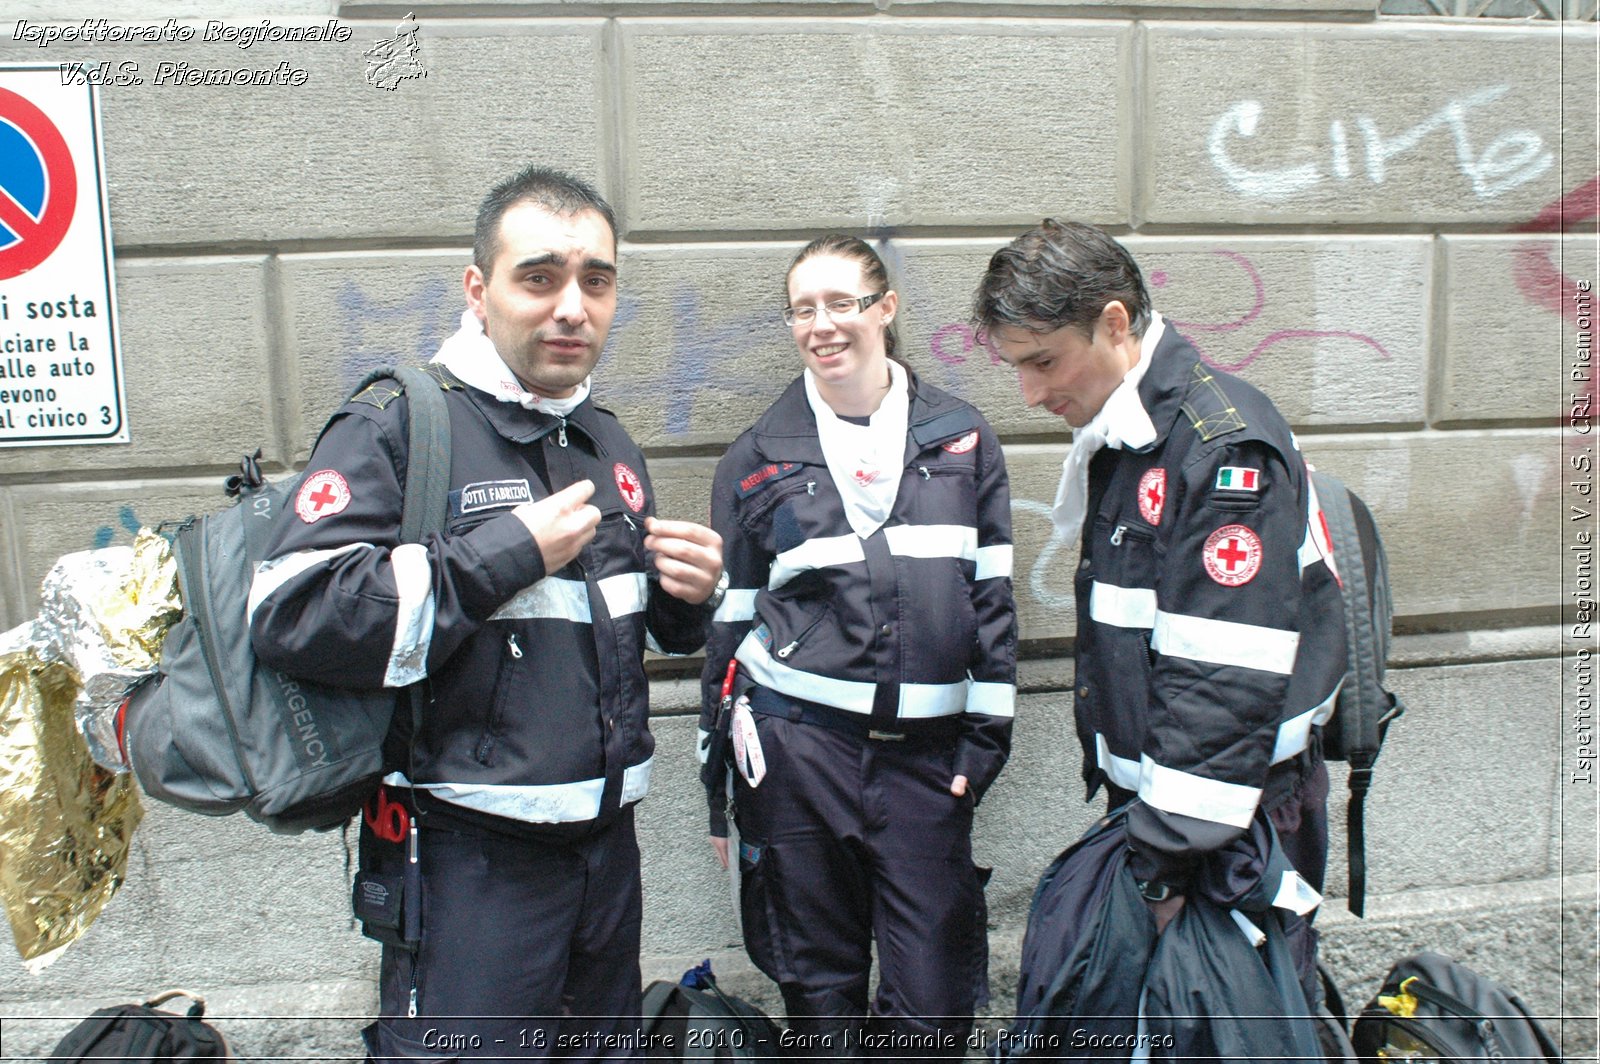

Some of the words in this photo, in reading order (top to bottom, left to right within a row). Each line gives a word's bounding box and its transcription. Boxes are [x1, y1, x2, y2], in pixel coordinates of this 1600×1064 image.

[27, 294, 97, 320] sosta
[0, 333, 56, 353] ciare
[69, 331, 89, 351] la
[50, 357, 95, 376] auto
[0, 388, 57, 403] evono
[28, 407, 87, 428] civico
[100, 406, 112, 425] 3
[488, 486, 528, 501] FABRIZIO
